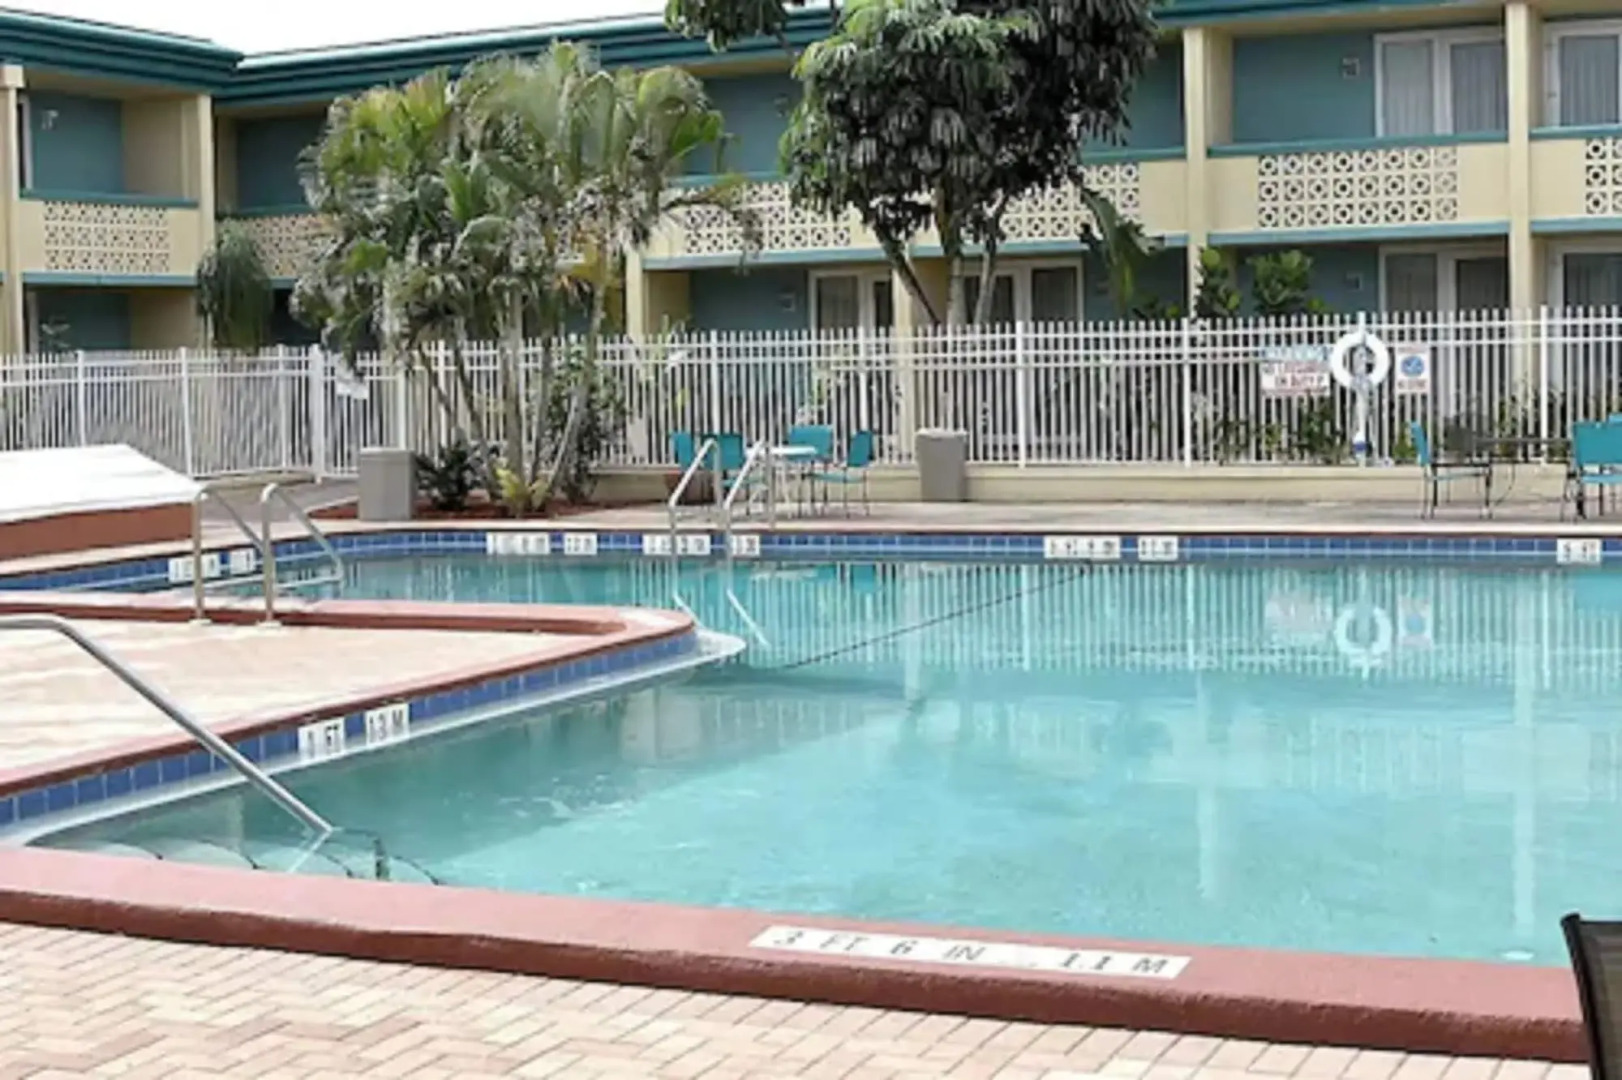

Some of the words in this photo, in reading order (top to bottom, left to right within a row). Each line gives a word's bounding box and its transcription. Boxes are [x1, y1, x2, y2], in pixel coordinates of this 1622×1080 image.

[773, 929, 805, 946] 3
[819, 932, 870, 952] FT
[889, 939, 920, 956] 6
[942, 944, 986, 962] IN
[1130, 956, 1170, 974] M
